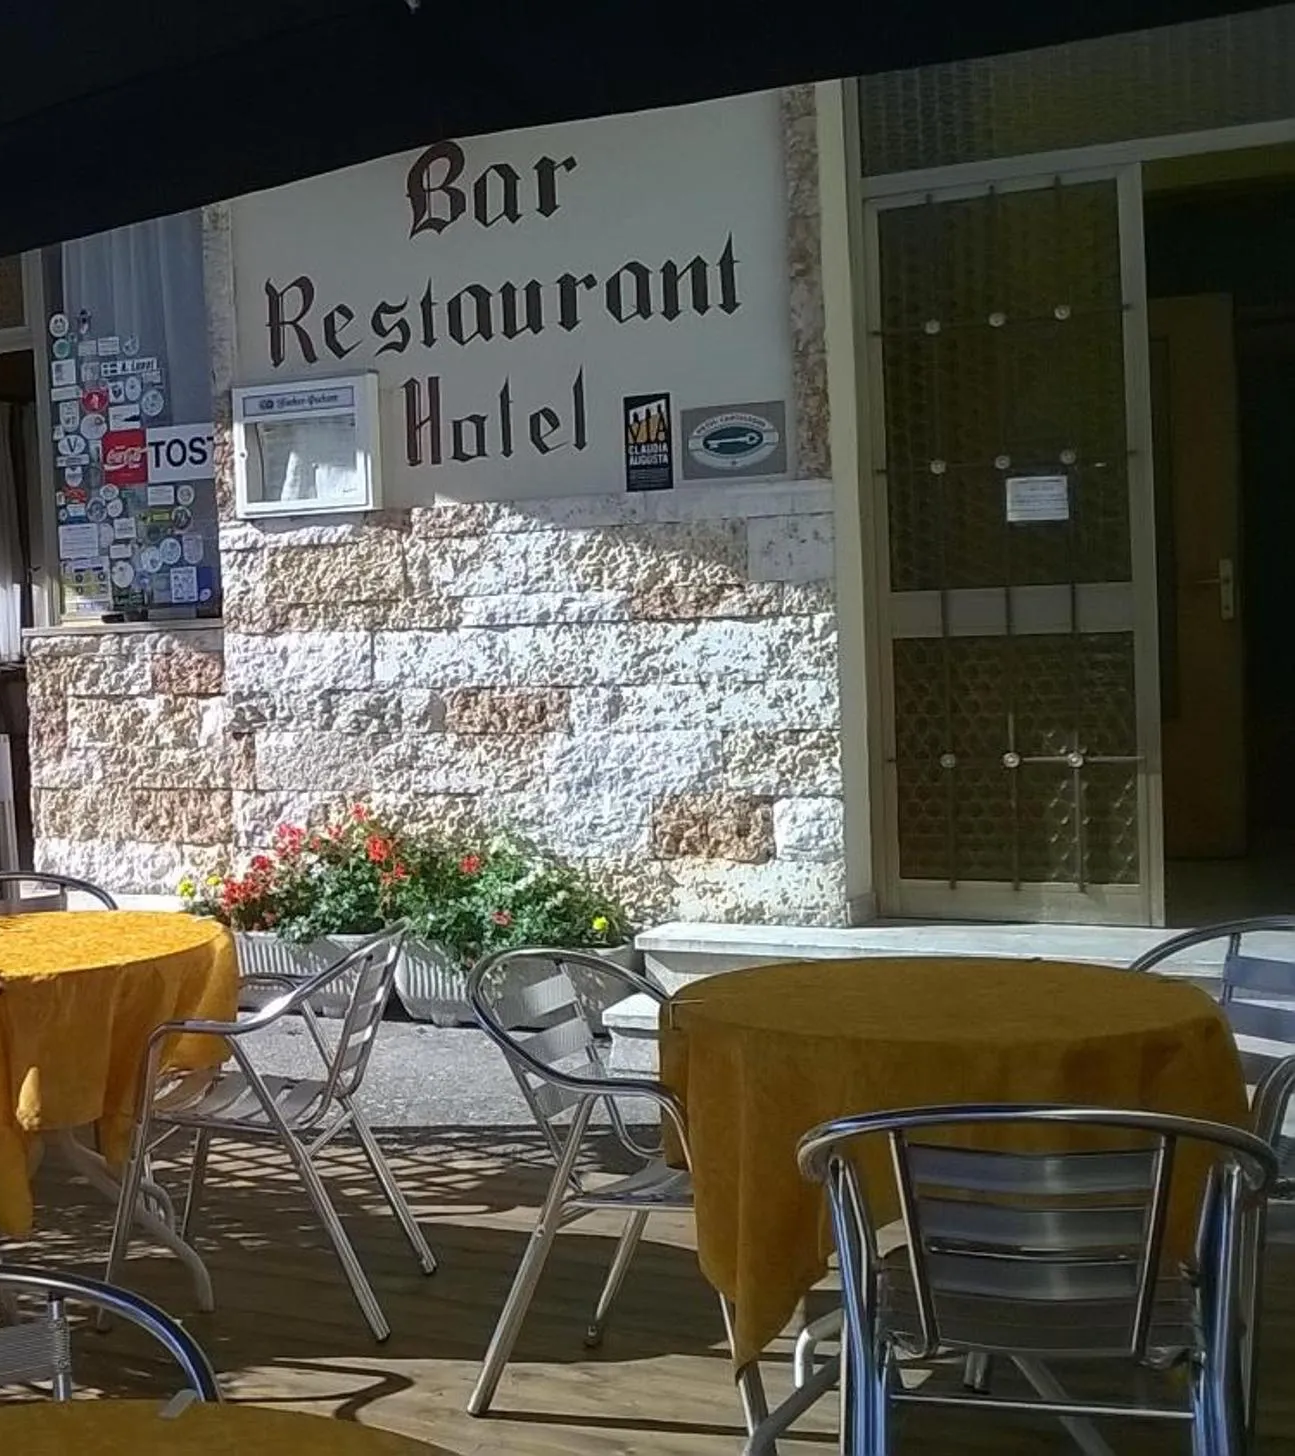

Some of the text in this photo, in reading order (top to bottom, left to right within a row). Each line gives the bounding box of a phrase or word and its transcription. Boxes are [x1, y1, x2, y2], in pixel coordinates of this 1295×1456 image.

[406, 140, 577, 239] Bar
[264, 231, 740, 368] Restaurant
[401, 364, 586, 467] Hotel
[628, 443, 668, 455] CLAUDIA
[629, 404, 667, 442] VIA
[629, 454, 668, 465] AUGUSTA
